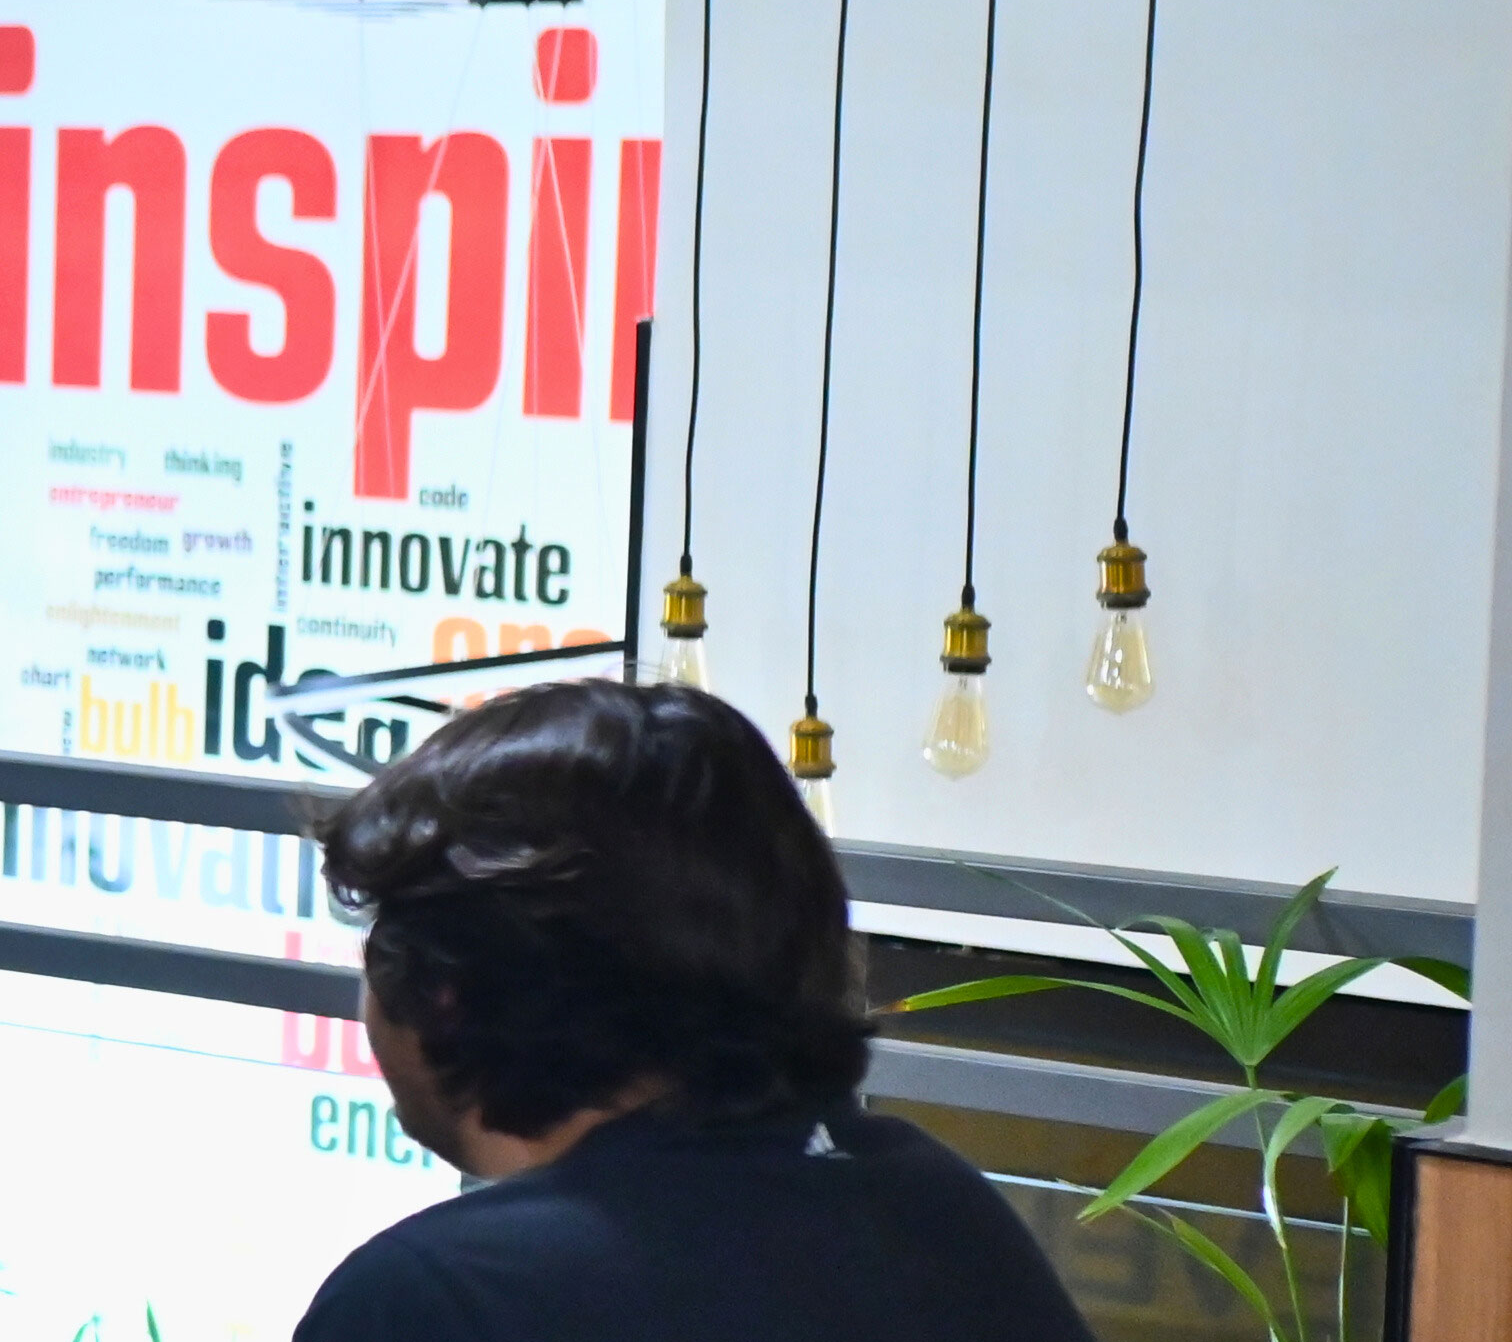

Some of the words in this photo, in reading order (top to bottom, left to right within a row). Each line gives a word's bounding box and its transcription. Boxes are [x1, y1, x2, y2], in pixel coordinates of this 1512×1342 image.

[164, 446, 244, 484] thinking
[418, 484, 469, 509] code
[89, 523, 170, 555] freedom
[182, 529, 253, 554] growth
[302, 500, 571, 605] innovate
[94, 563, 221, 597] performance
[296, 614, 398, 649] continuity
[87, 646, 166, 672] network
[21, 667, 70, 689] chart
[79, 674, 196, 763] bulb
